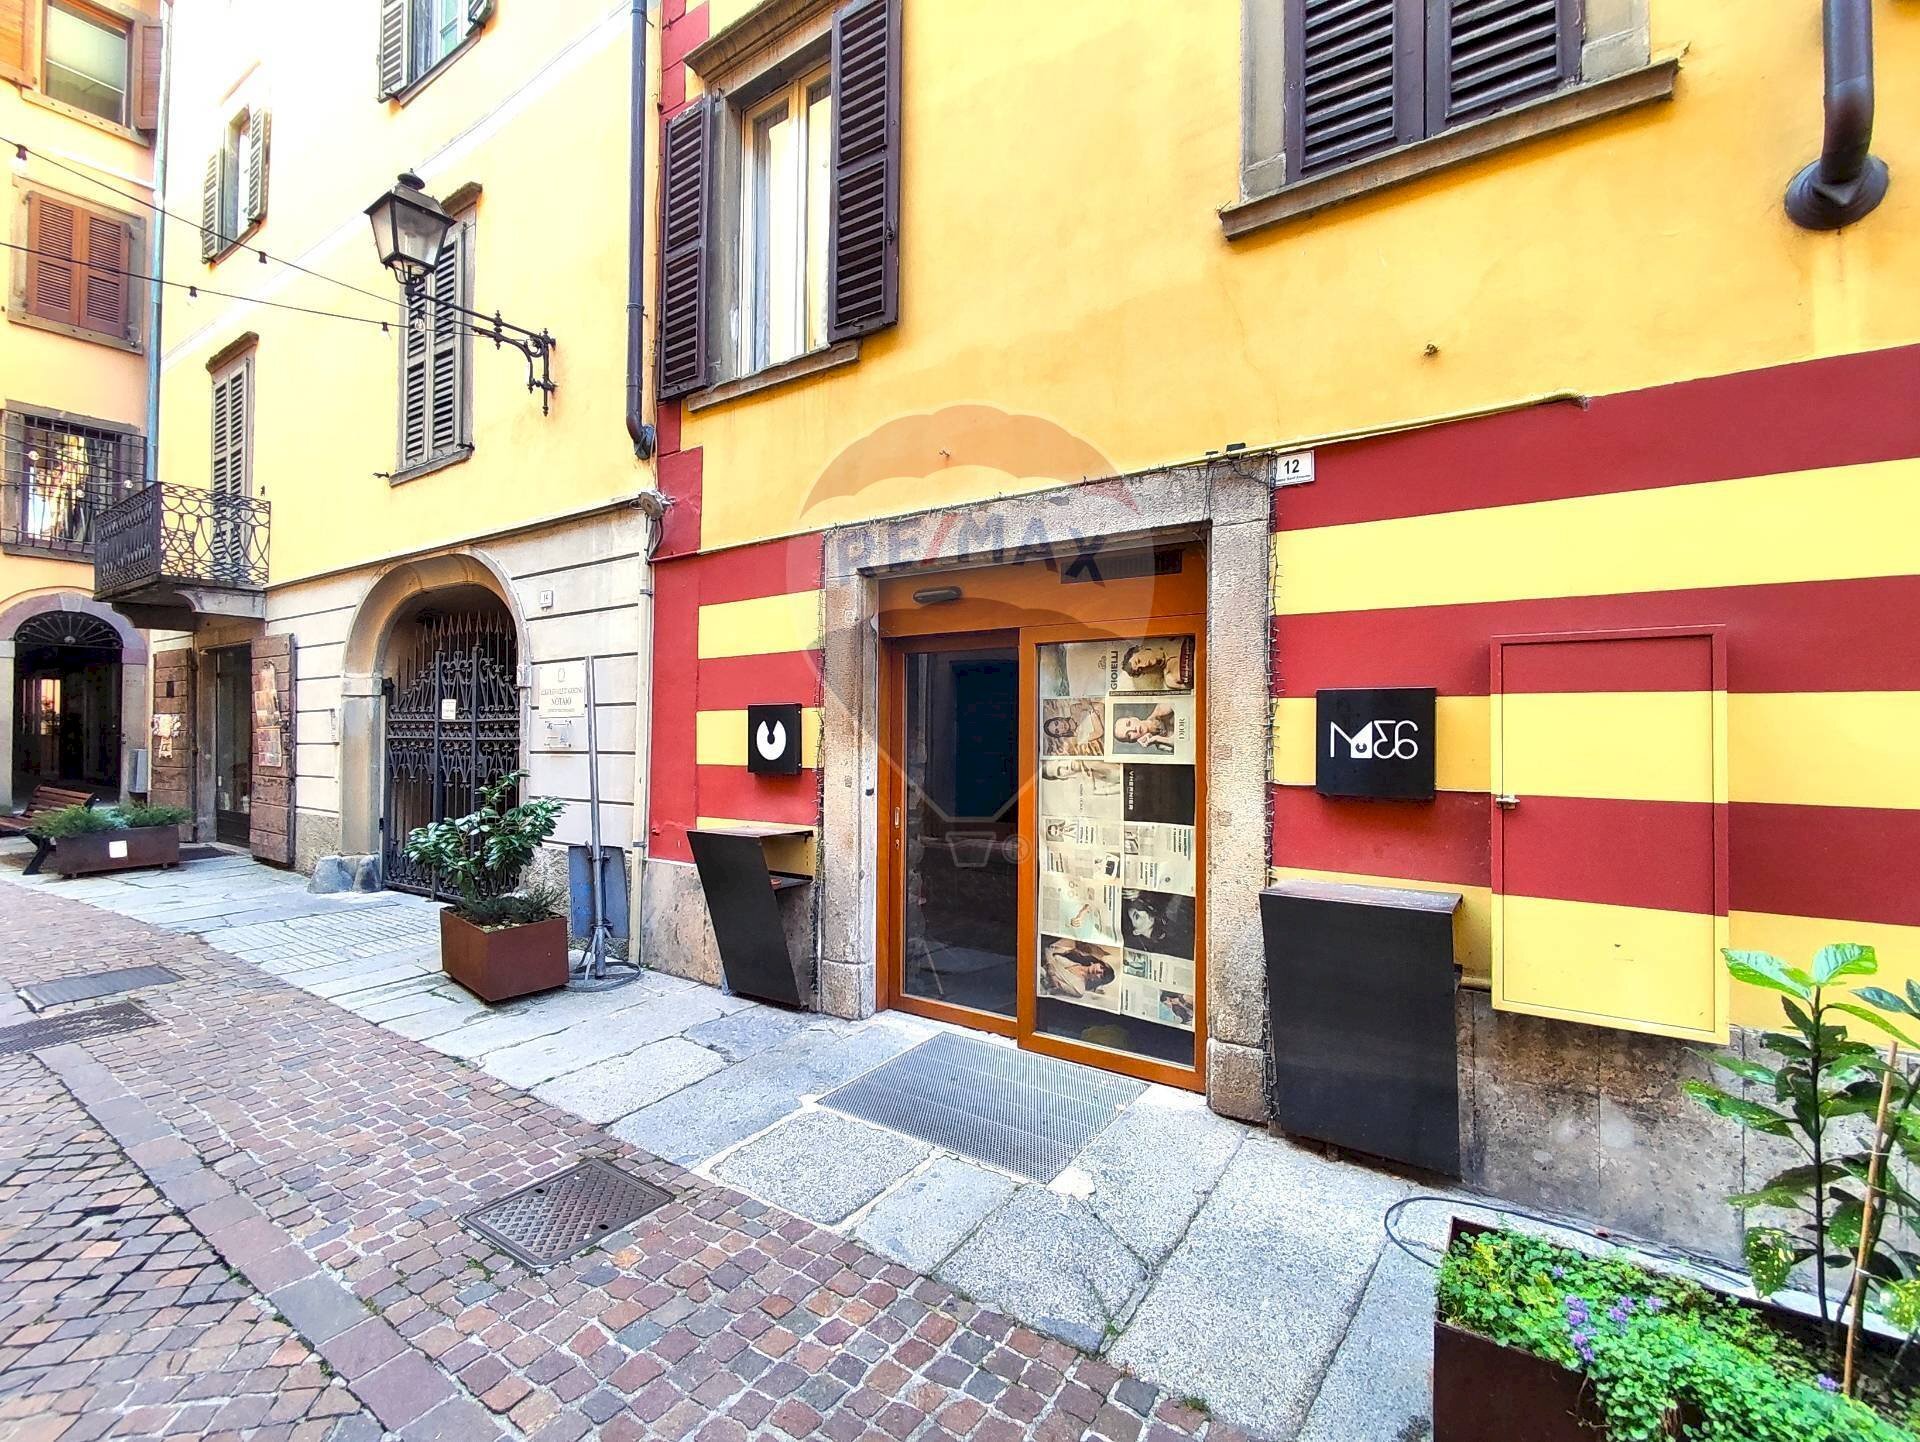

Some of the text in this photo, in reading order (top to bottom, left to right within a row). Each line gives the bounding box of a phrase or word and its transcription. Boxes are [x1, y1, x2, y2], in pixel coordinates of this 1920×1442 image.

[1283, 459, 1300, 475] 12
[1110, 650, 1119, 691] GIOIELLI
[1178, 718, 1186, 740] DIOR
